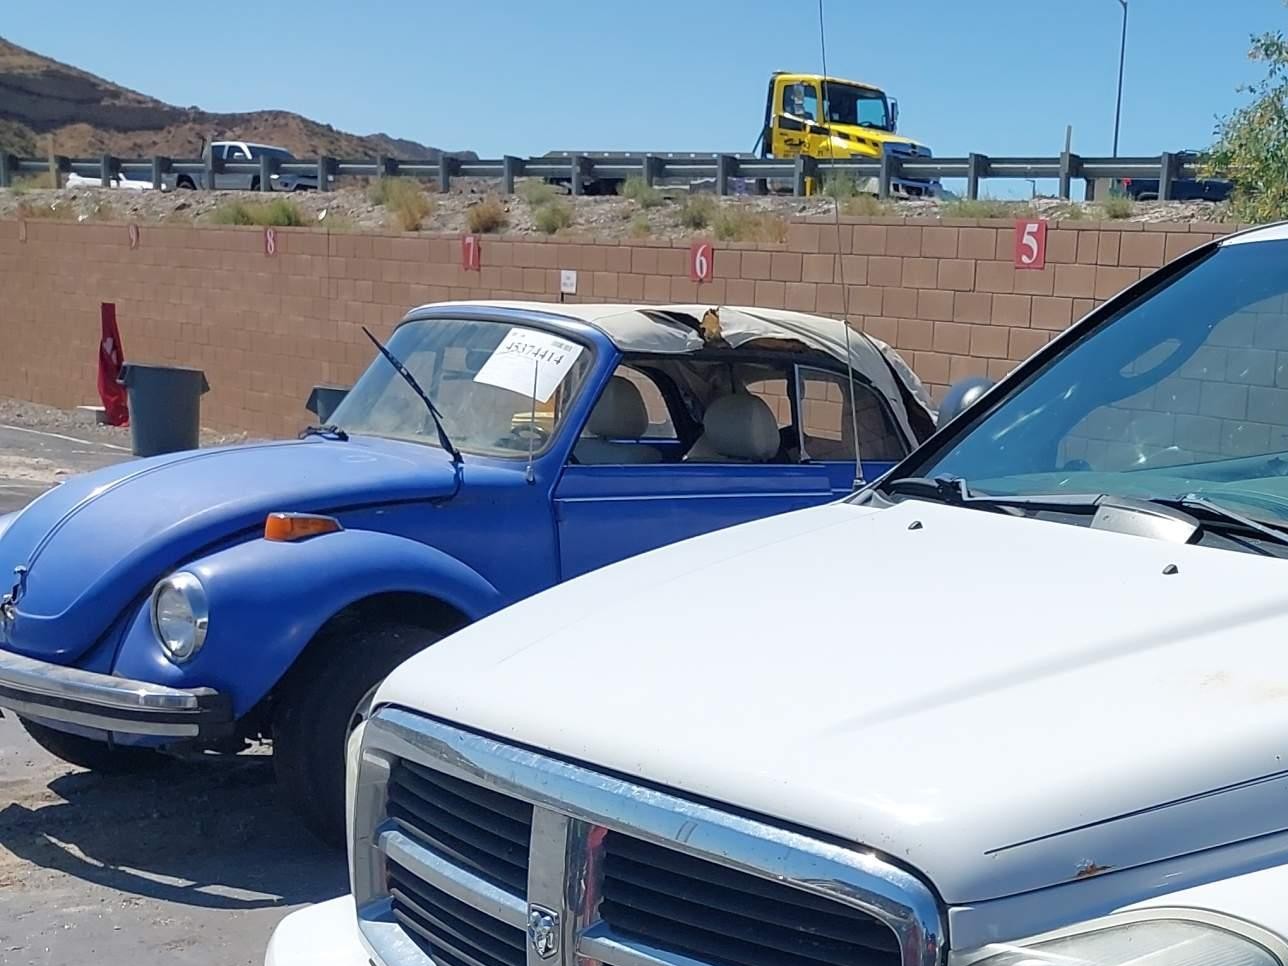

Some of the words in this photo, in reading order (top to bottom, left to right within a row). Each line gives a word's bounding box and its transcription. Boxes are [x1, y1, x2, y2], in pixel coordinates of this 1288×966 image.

[266, 228, 275, 255] 8
[465, 236, 474, 266] 7
[1021, 223, 1039, 264] 5
[695, 244, 708, 279] 6
